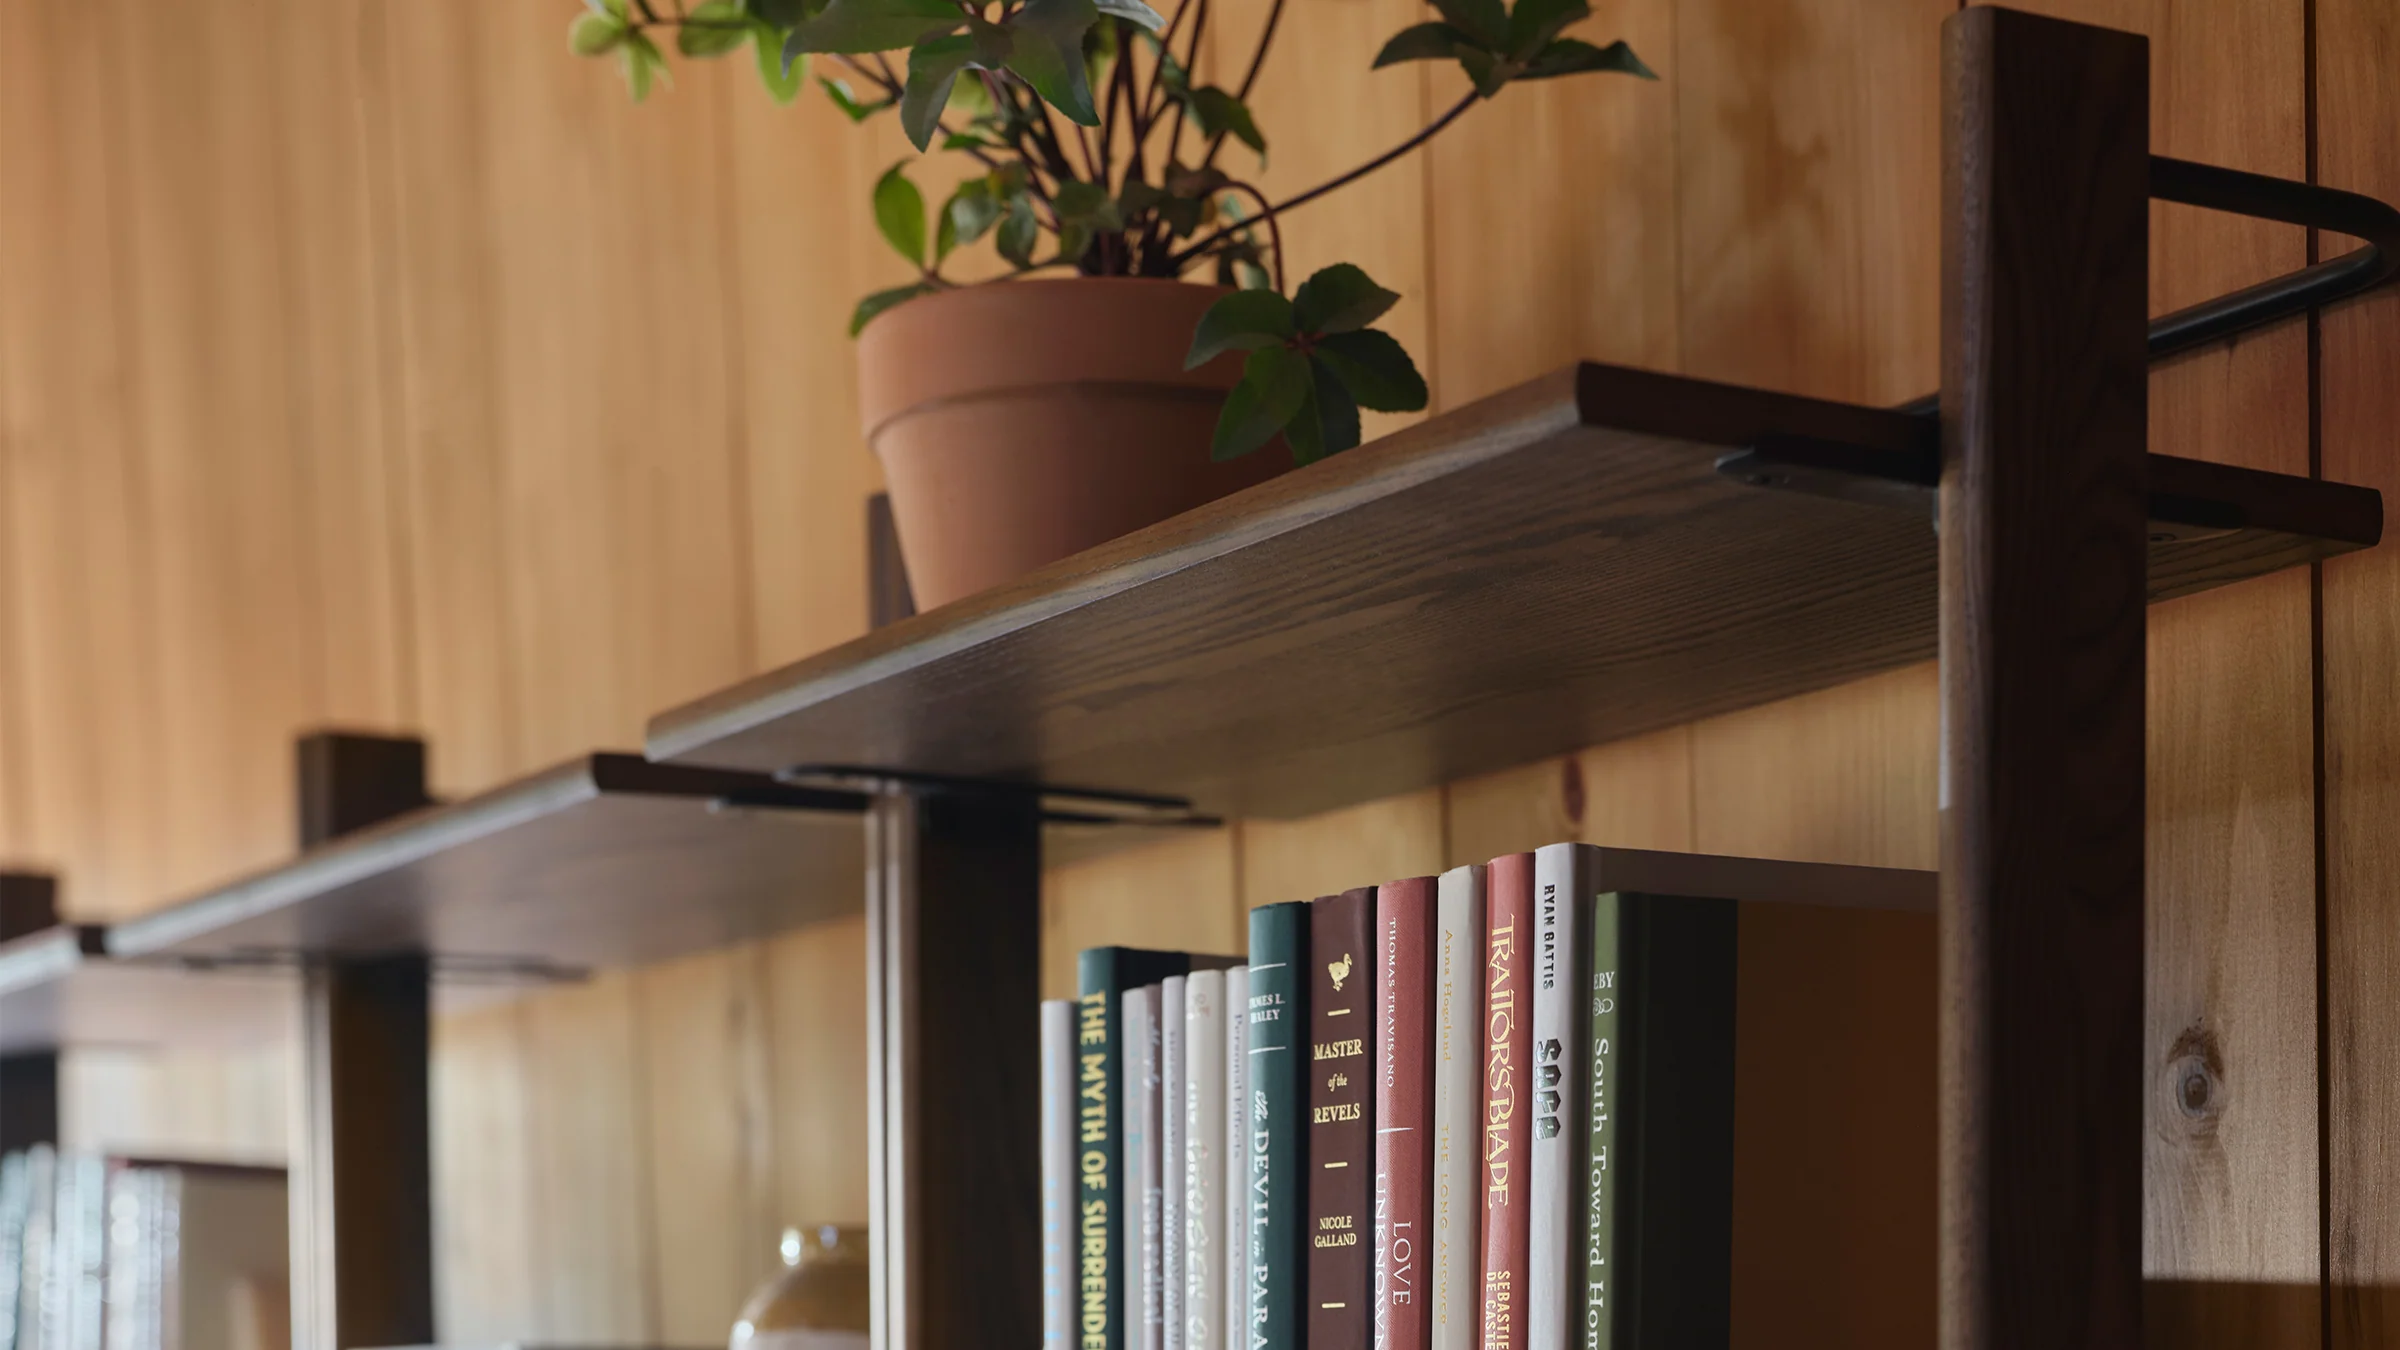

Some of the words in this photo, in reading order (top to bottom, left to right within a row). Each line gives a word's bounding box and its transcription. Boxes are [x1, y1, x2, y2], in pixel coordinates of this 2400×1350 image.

[1543, 884, 1555, 926] RYAN
[1388, 917, 1397, 987] THOMAS
[1444, 929, 1453, 975] Anna
[1543, 931, 1555, 990] GATTIS
[1080, 990, 1107, 1046] THE
[1442, 982, 1453, 1061] Hogeland
[1489, 913, 1515, 1092] TRAITOR'S
[1313, 1039, 1363, 1060] MASTER
[1387, 991, 1396, 1088] TRAVISANO
[1081, 1052, 1107, 1144] MYTH
[1313, 1103, 1361, 1123] REVELS
[1327, 1073, 1338, 1092] of
[1336, 1073, 1348, 1087] the
[1592, 1038, 1609, 1134] South
[1081, 1150, 1108, 1190] OF
[1440, 1123, 1450, 1163] THE
[1486, 1084, 1515, 1210] BLADE
[1253, 1128, 1269, 1235] DEVIL
[1439, 1172, 1449, 1230] LONG
[1589, 1145, 1607, 1267] Toward
[1314, 1233, 1357, 1248] GALLAND
[1319, 1215, 1353, 1230] NICOLE
[1081, 1199, 1107, 1350] SURRENDE
[1374, 1173, 1386, 1350] UNKNOWN
[1392, 1221, 1412, 1306] LOVE
[1486, 1271, 1497, 1293] DE
[1252, 1262, 1269, 1350] PARA
[1485, 1299, 1497, 1350] CASTE
[1496, 1270, 1511, 1350] SEBASTIE
